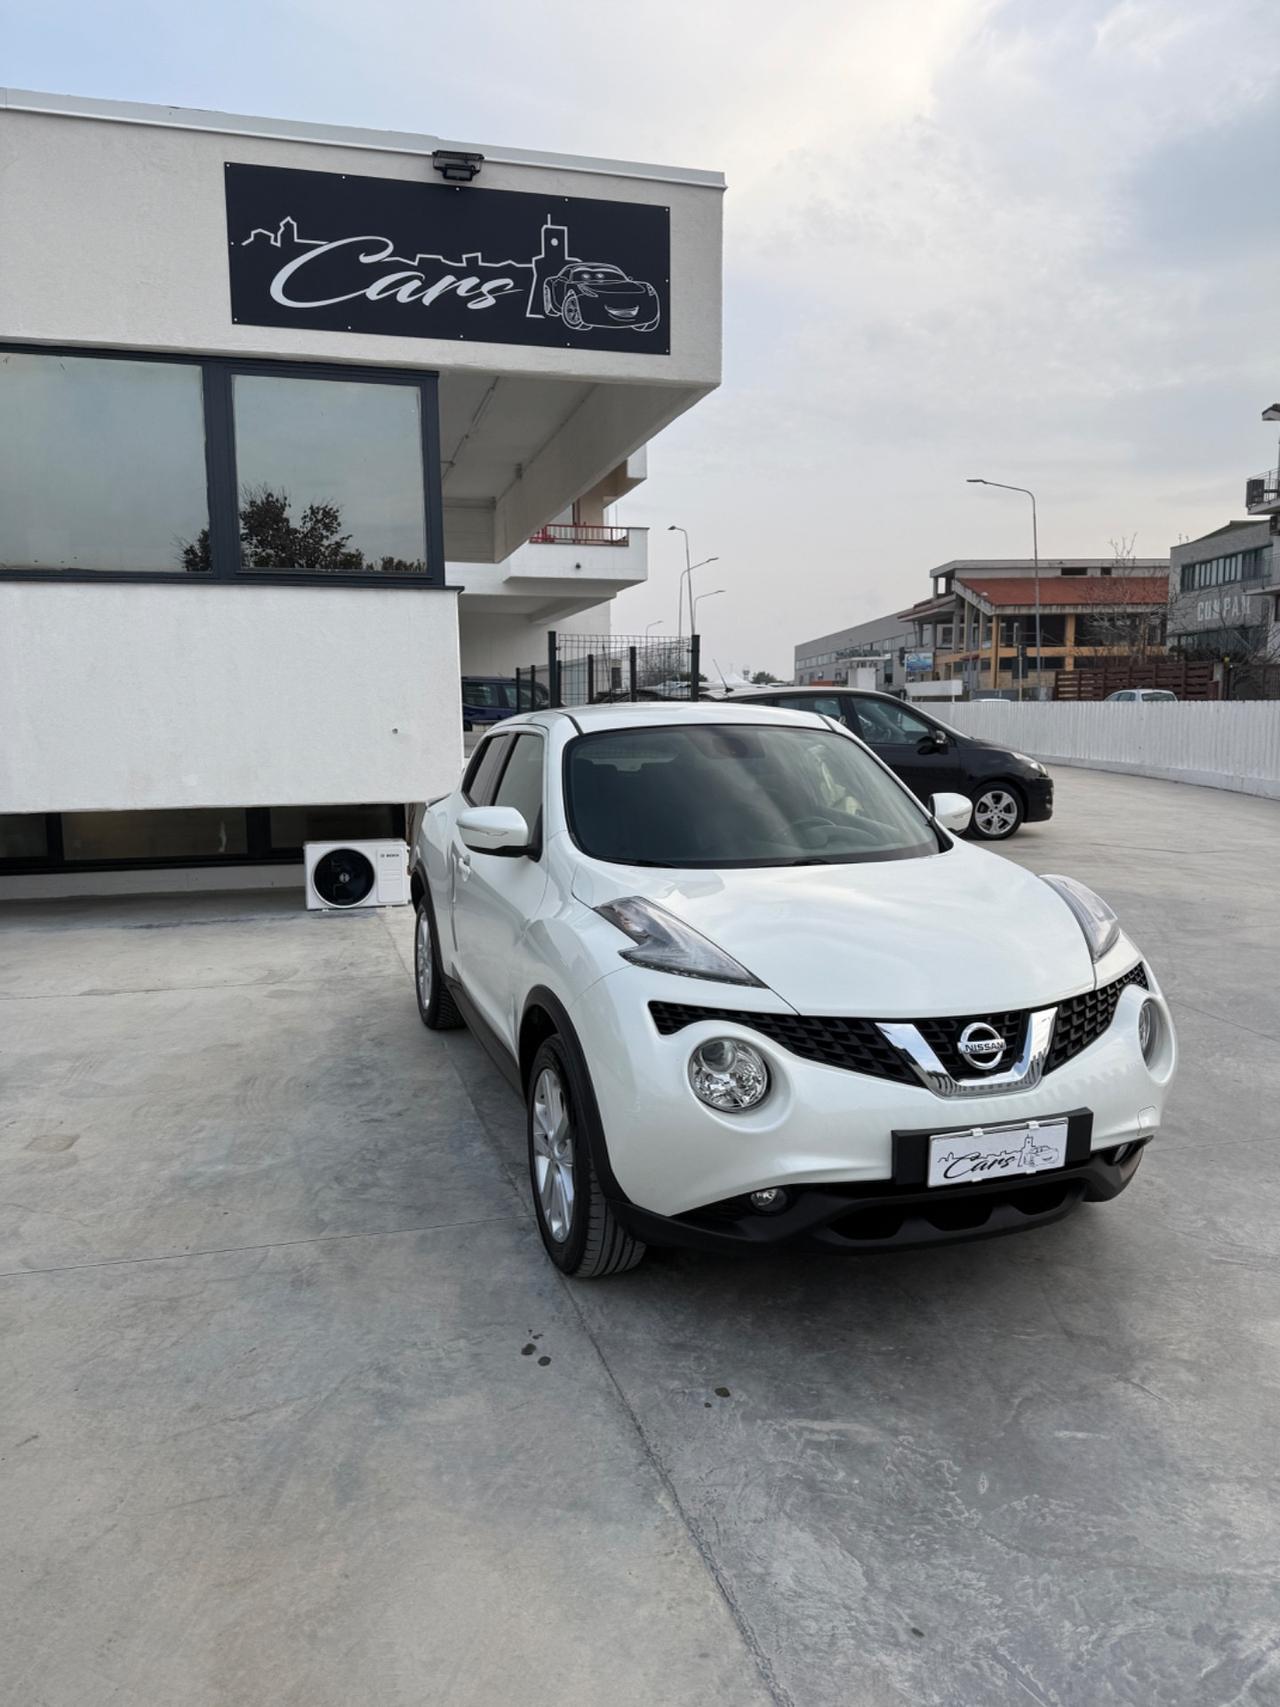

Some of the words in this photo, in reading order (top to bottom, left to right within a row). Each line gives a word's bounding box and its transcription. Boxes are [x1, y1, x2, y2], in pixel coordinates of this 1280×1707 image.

[270, 235, 524, 310] Cars
[964, 1040, 1004, 1052] NISSAN
[943, 1152, 1018, 1180] Cars
